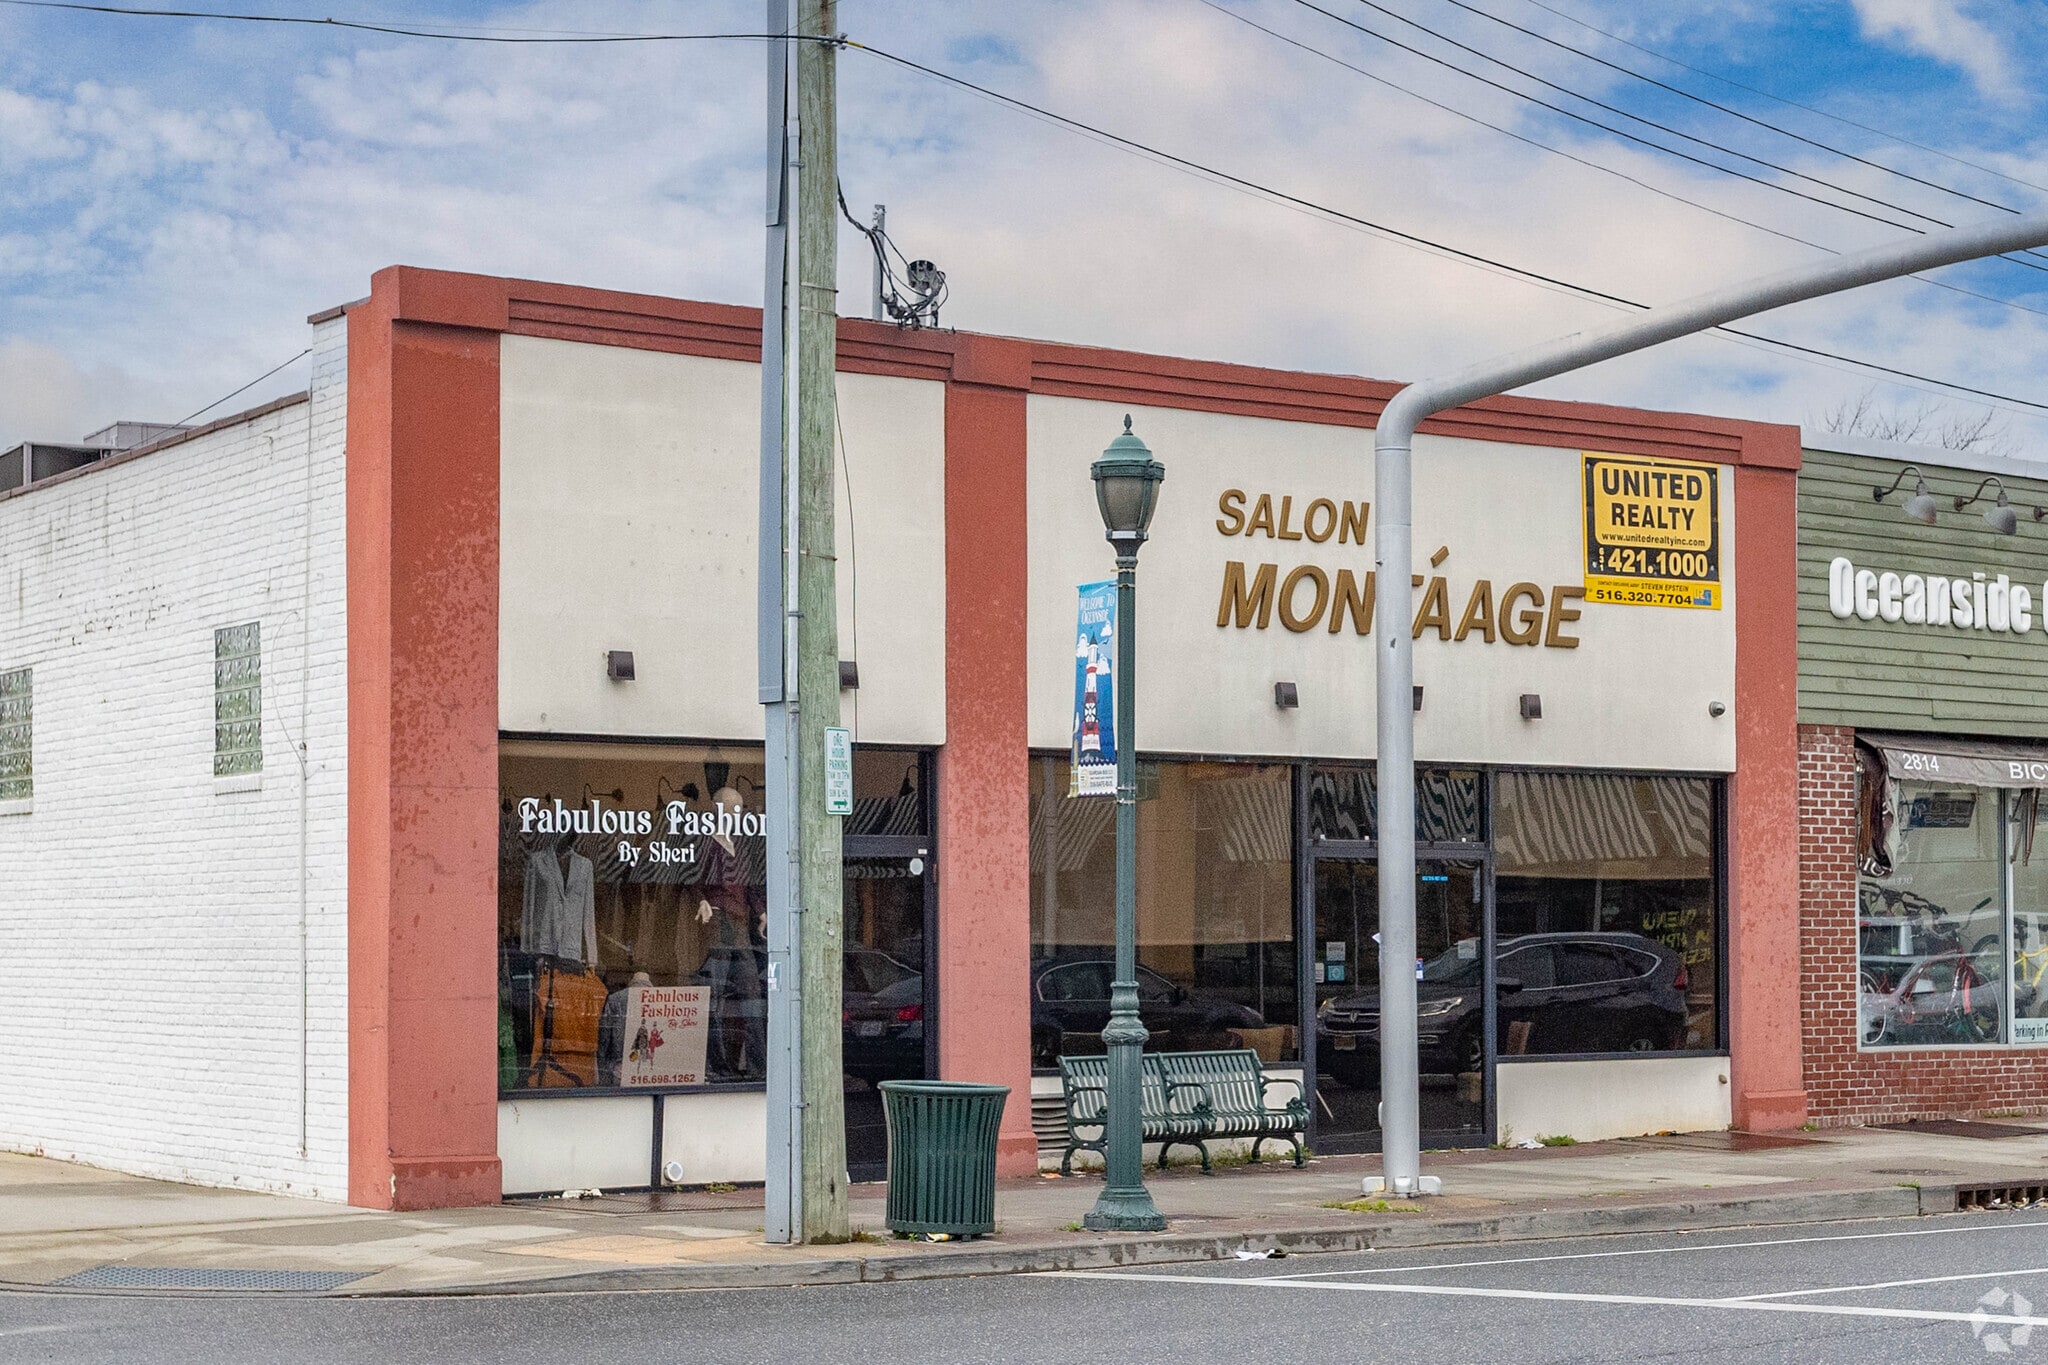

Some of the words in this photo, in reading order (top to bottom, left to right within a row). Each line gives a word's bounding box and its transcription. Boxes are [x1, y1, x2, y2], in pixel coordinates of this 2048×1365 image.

[1602, 468, 1703, 502] UNITED
[1216, 488, 1371, 546] SALON
[1611, 502, 1695, 531] REALTY
[1601, 532, 1706, 547] www.unitedrealtyinc.com
[1607, 548, 1709, 578] 421.1000
[1216, 545, 1587, 650] MONÁAGE
[1596, 589, 1692, 605] 516.320.7704
[1641, 582, 1664, 592] STEVEN
[1665, 584, 1689, 593] EPSTEIN
[1829, 557, 2032, 635] Oceanside
[829, 759, 848, 770] PARKING
[1902, 753, 1940, 772] 2814
[517, 797, 652, 835] Fabulous
[618, 841, 640, 867] By
[649, 841, 695, 866] Sheri
[641, 989, 699, 1004] Fabulous
[641, 1004, 698, 1018] Fashions
[630, 1074, 696, 1085] 516.698.1262
